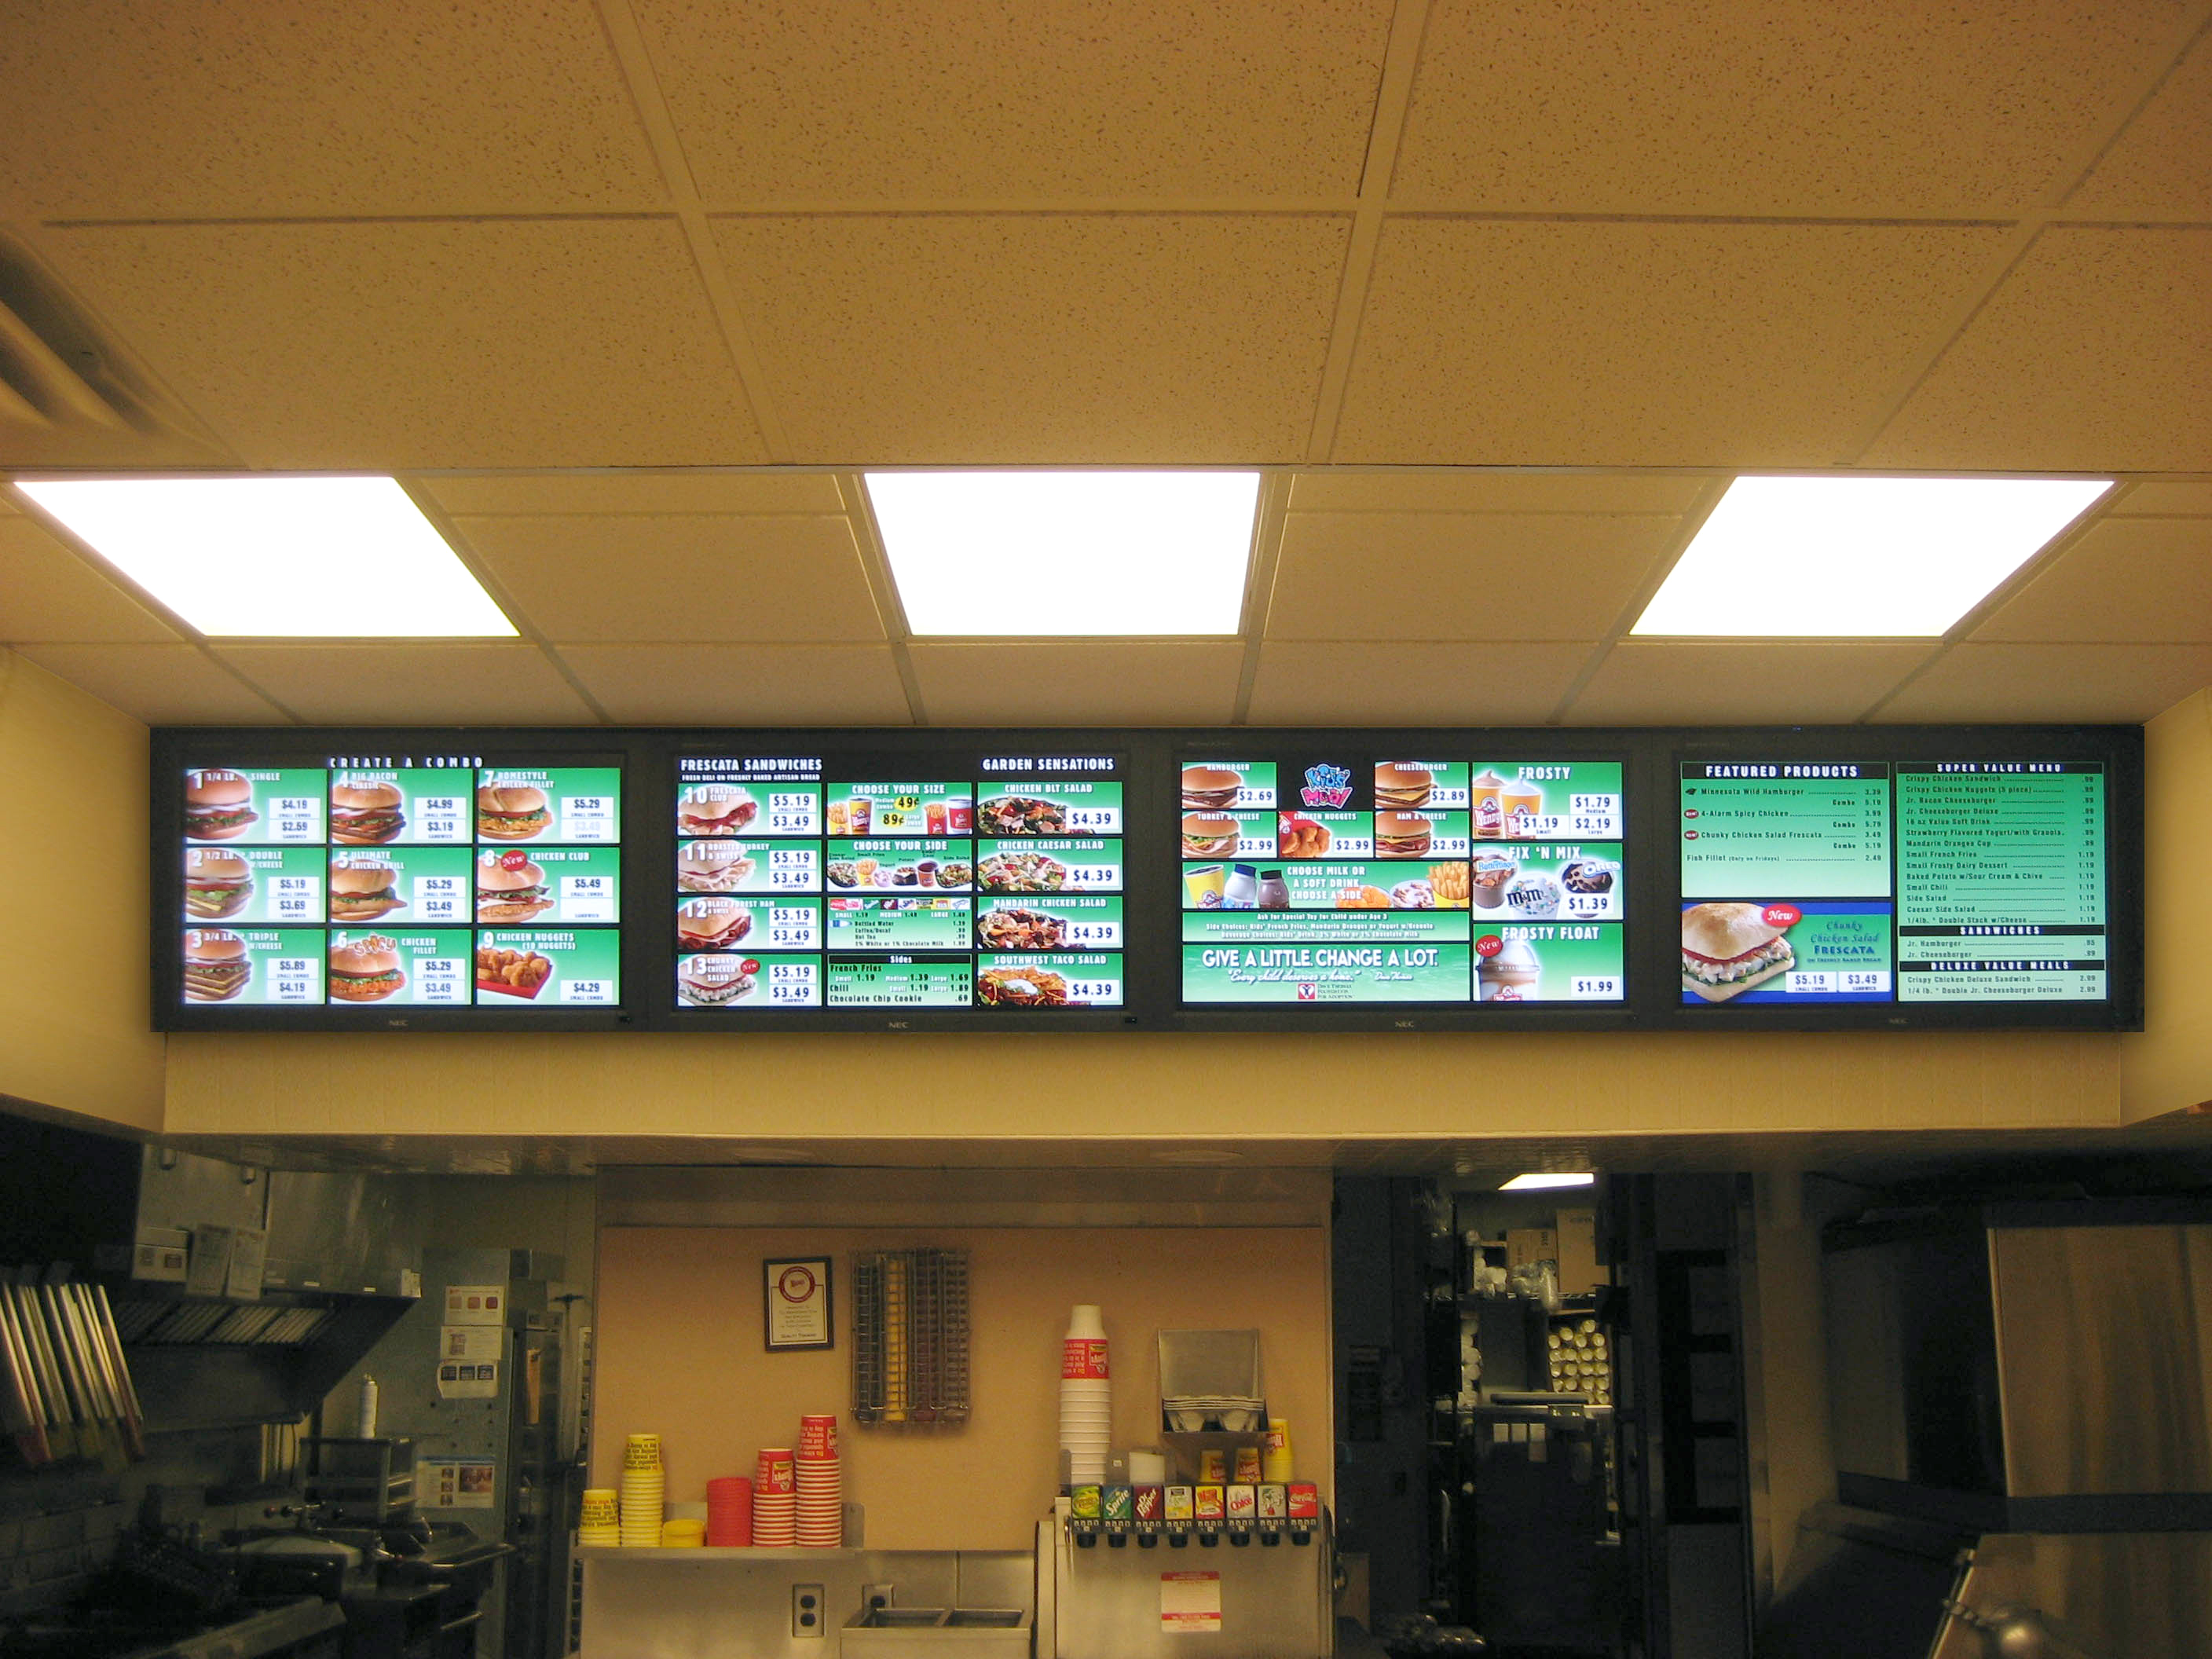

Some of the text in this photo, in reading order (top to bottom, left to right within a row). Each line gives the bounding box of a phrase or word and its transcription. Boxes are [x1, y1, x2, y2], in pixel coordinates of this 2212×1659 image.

[330, 757, 482, 767] CREATE A COMBO
[680, 760, 822, 771] FRESCATA SANDWICHES
[983, 759, 1114, 770] GARDEN SENSATIONS
[1518, 767, 1570, 779] FROSTY
[1705, 766, 1858, 777] FEATURED PRODUCTS
[1937, 764, 2060, 772] SUPER VALUE MENU
[485, 771, 495, 788] 7
[851, 785, 945, 794] CHOOSE YOUR SIZE
[685, 787, 708, 804] 10
[774, 795, 810, 806] $5.19
[1240, 791, 1272, 800] $2.69
[282, 800, 307, 810] $4.19
[574, 800, 600, 808] $5.29
[1576, 797, 1610, 808] $1.79
[773, 816, 809, 826] $3.49
[1073, 813, 1111, 825] $4.39
[1523, 818, 1558, 828] $1.19
[1576, 819, 1610, 829] $2.19
[427, 822, 453, 831] $3.19
[853, 841, 947, 850] CHOOSE YOUR SIDE
[1240, 840, 1273, 850] $2.99
[1336, 840, 1369, 850] $2.99
[1433, 840, 1465, 850] $2.99
[686, 844, 705, 860] 11
[774, 852, 810, 862] $5.19
[1074, 870, 1112, 881] $4.39
[1287, 866, 1365, 875] CHOOSE MILK OR
[773, 873, 809, 883] $3.49
[280, 880, 306, 889] $5.19
[427, 880, 452, 889] $5.29
[575, 879, 601, 888] $5.49
[1294, 879, 1360, 888] A SOFT DRINK
[1291, 891, 1327, 899] CHOOSE
[427, 902, 452, 910] $3.49
[993, 899, 1038, 907] MANDARIN
[1042, 899, 1077, 907] CHICKEN
[1569, 898, 1607, 910] $1.39
[686, 901, 707, 917] 12
[1767, 910, 1793, 921] New
[1074, 927, 1112, 938] $4.39
[1502, 927, 1599, 940] FROSTY FLOAT
[338, 932, 347, 948] 6
[483, 932, 494, 948] 9
[994, 955, 1107, 964] SOUTHWEST TACO SALAD
[1202, 949, 1438, 967] GIVE A LITTLE. CHANGE A LOT.
[426, 961, 451, 971] $5.29
[686, 958, 707, 974] 13
[1984, 961, 2022, 970] VALUE
[1796, 974, 1877, 984] $5.19 $3.49
[280, 983, 305, 992] $4.19
[426, 983, 451, 992] $3.49
[573, 983, 599, 992] $4.29
[1073, 983, 1111, 995] $4.39
[1578, 981, 1613, 991] $1.99
[1106, 1489, 1130, 1516] Sprite
[1138, 1492, 1148, 1503] Dr
[1137, 1488, 1157, 1518] Pepper
[1230, 1496, 1253, 1511] Coke
